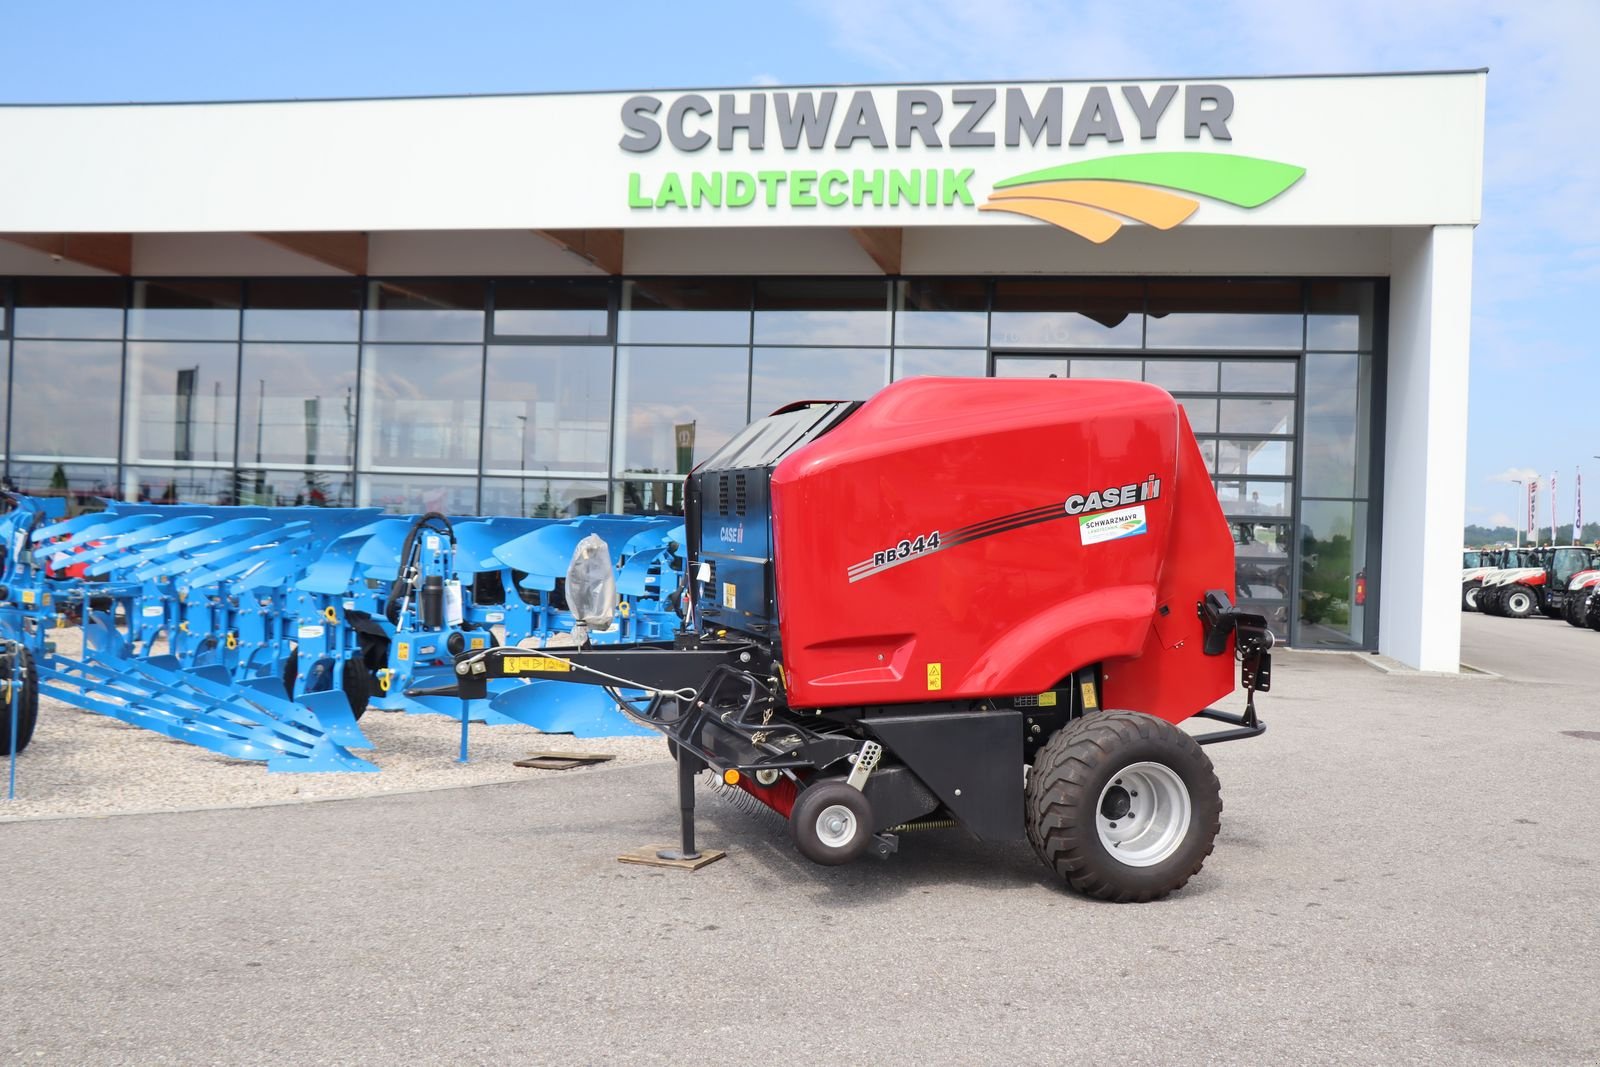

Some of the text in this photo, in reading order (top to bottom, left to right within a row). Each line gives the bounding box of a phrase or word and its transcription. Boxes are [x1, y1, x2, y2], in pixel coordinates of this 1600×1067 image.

[618, 84, 1235, 153] SCHWARZMAYR
[628, 168, 975, 209] LANDTECHNIK
[1064, 483, 1138, 515] CASE
[720, 526, 737, 543] CASE
[1085, 513, 1137, 529] SCHWARZMAYR
[874, 530, 941, 567] RB344
